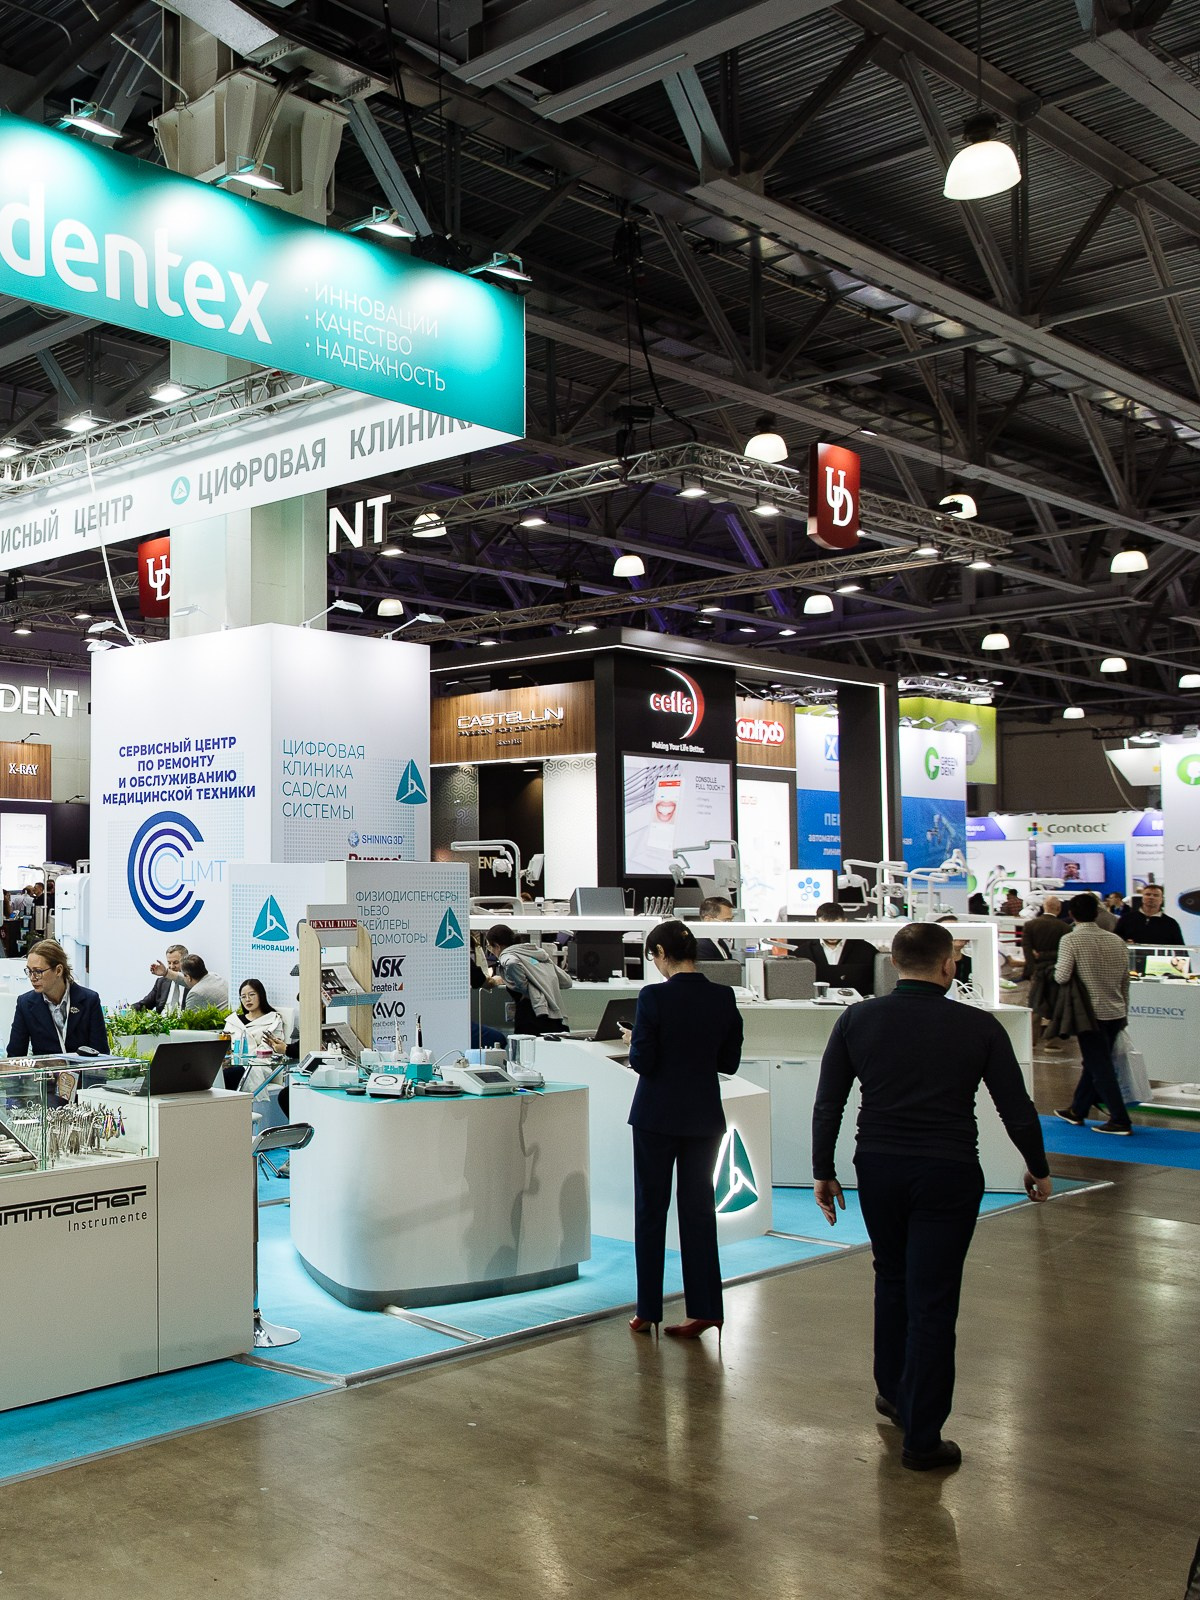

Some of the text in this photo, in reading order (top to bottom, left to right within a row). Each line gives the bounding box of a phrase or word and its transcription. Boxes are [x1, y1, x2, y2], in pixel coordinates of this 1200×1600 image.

[314, 281, 439, 339] ИННОВАЦИИ
[315, 309, 413, 356] КАЧЕСТВО
[316, 336, 446, 392] НАДЕЖНОСТЬ
[198, 410, 474, 505] ЦИФРОВАЯ КЛИНИК
[73, 494, 134, 536] ЦЕНТР
[457, 706, 564, 729] CASTELLINI
[119, 736, 237, 758] СЕРВИСНЫЙ ЦЕНТР
[282, 739, 365, 760] ЦИФРОВАЯ
[8, 762, 39, 776] X-RAY
[137, 754, 215, 772] ПО РЕМОНТУ
[282, 760, 354, 779] КЛИНИКА
[118, 769, 237, 788] И ОБСЛУЖИВАНИЮ
[102, 785, 256, 806] МЕДИЦИНСКОЙ ТЕХНИКИ
[282, 780, 347, 800] CAD/CAM
[282, 802, 354, 820] СИСТЕМЫ
[1047, 823, 1108, 834] Contact
[361, 834, 393, 845] SHINING
[355, 891, 459, 903] ФИЗИОДИСПЕНСЕРЫ
[336, 919, 357, 928] TIMES
[251, 943, 295, 952] ИННОВАЦИИ
[371, 933, 428, 945] ДОМОТОРЫ
[1130, 1006, 1186, 1016] MEDENCY
[67, 1210, 148, 1232] Instrumente
